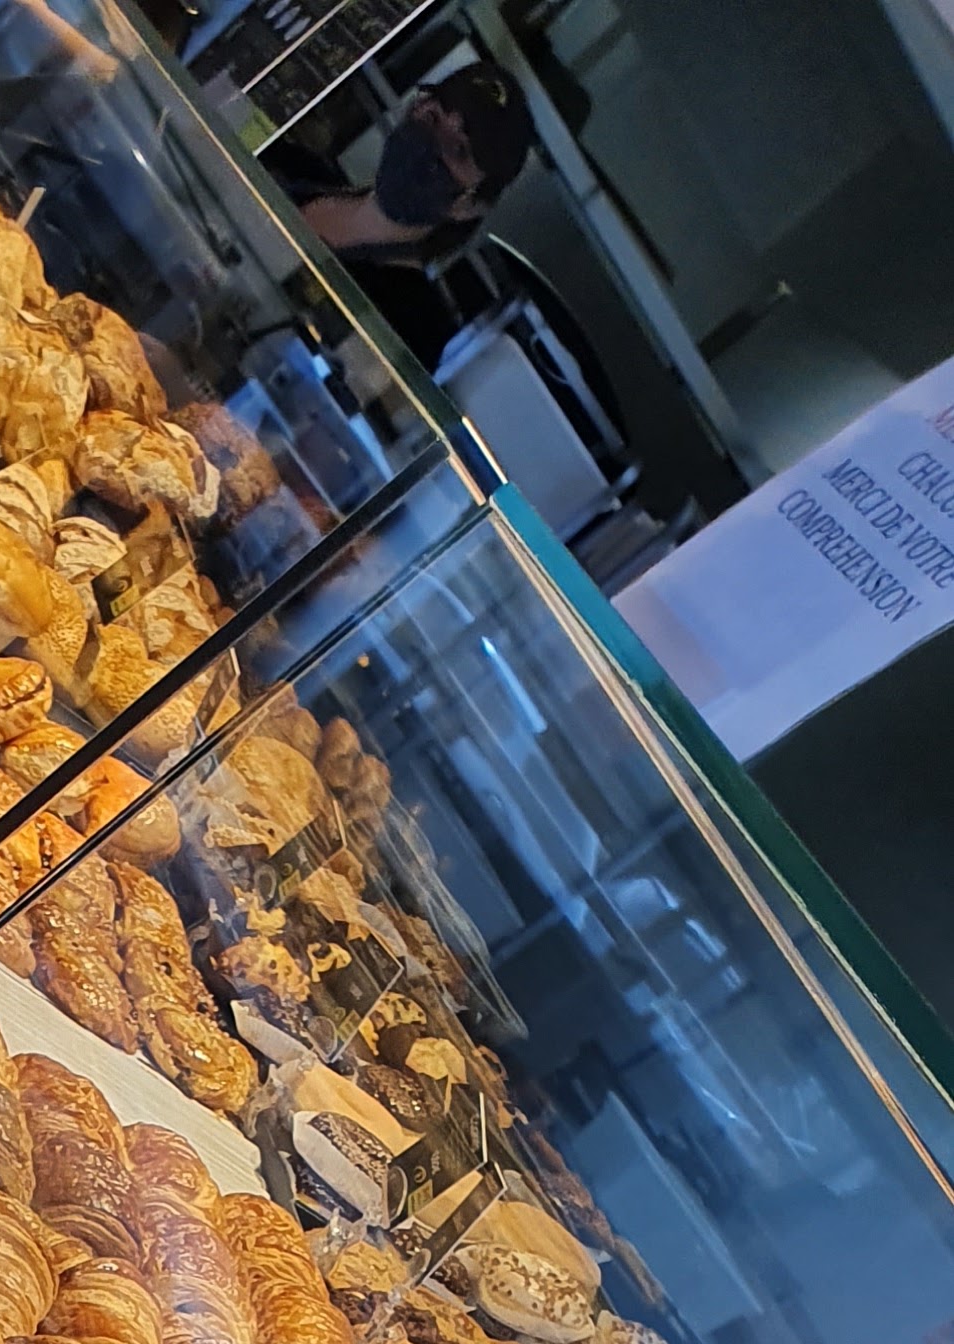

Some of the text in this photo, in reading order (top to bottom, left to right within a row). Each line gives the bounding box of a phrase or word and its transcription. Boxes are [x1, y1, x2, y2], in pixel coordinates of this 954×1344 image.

[777, 488, 922, 625] COMPREHENSION
[821, 458, 954, 589] MERCI DE VOTRE
